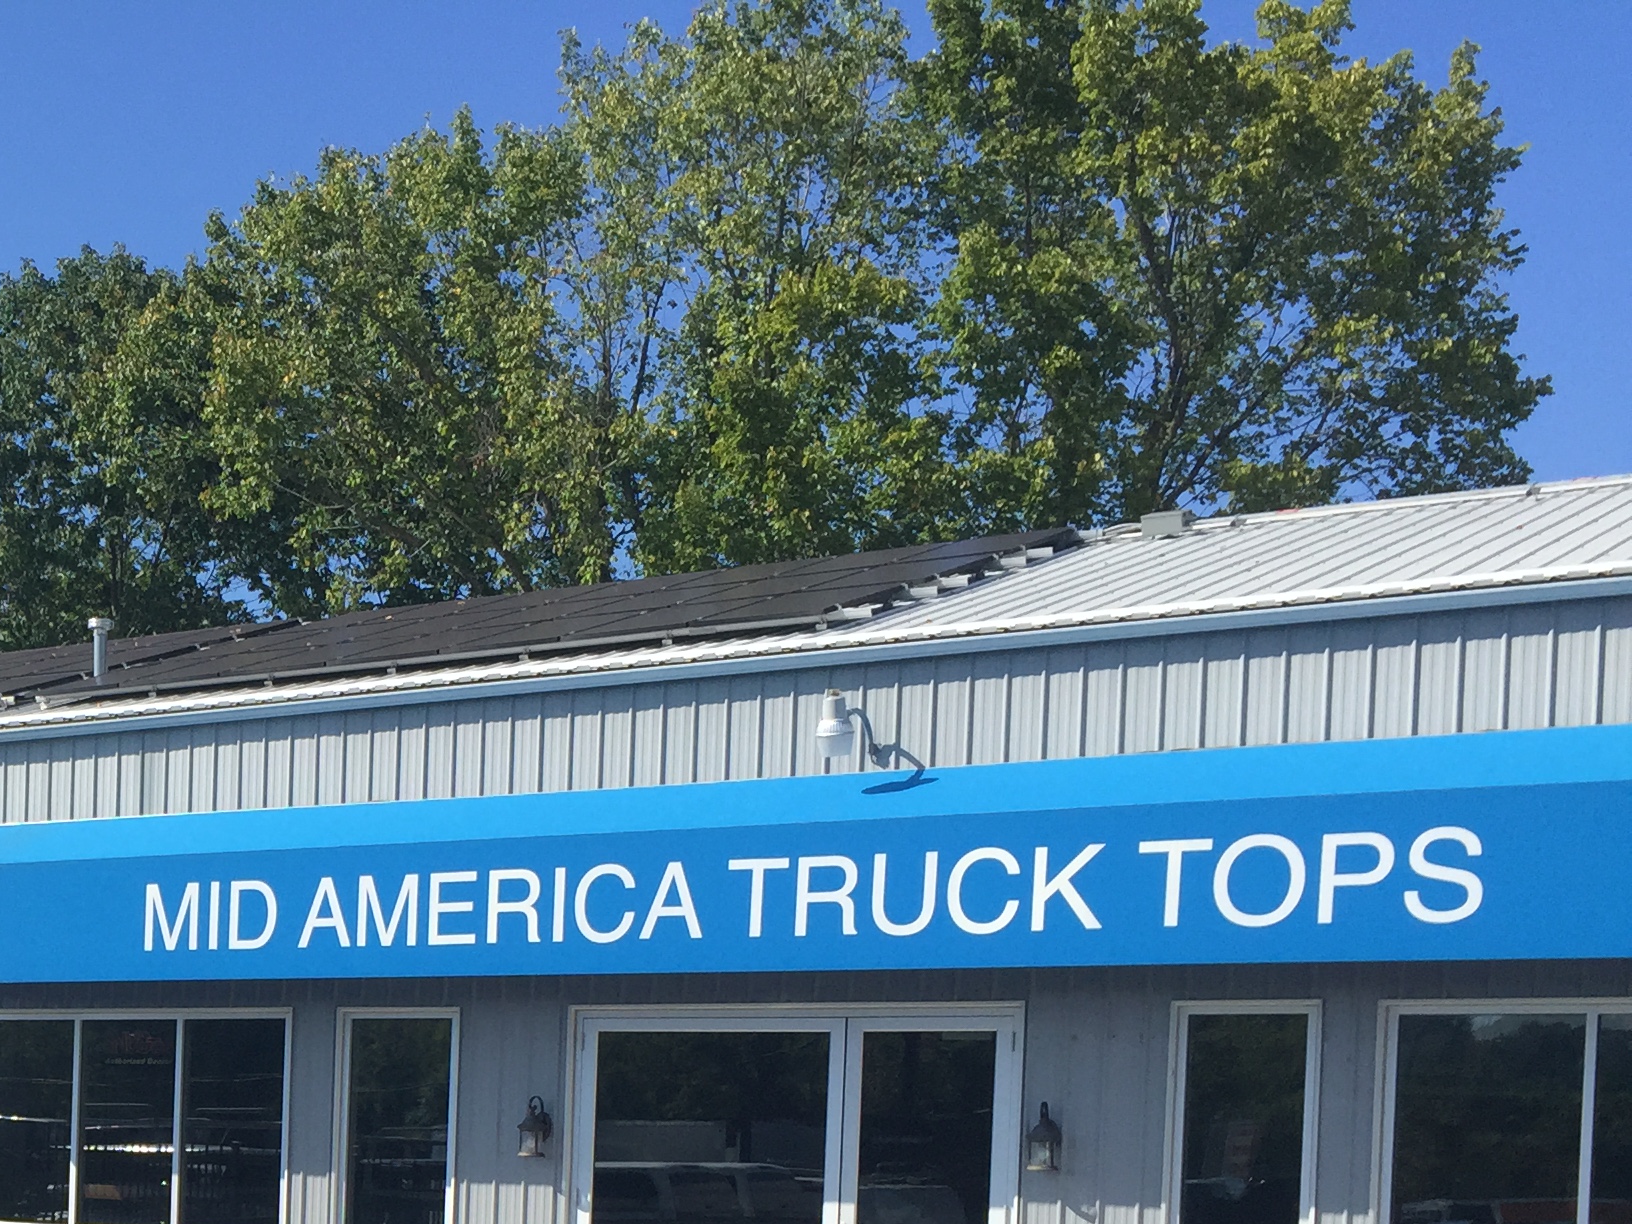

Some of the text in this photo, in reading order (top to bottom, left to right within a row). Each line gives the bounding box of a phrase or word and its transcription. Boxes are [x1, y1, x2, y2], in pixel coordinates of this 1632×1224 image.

[144, 826, 1484, 952] MID AMERICA TRUCK TOPS
